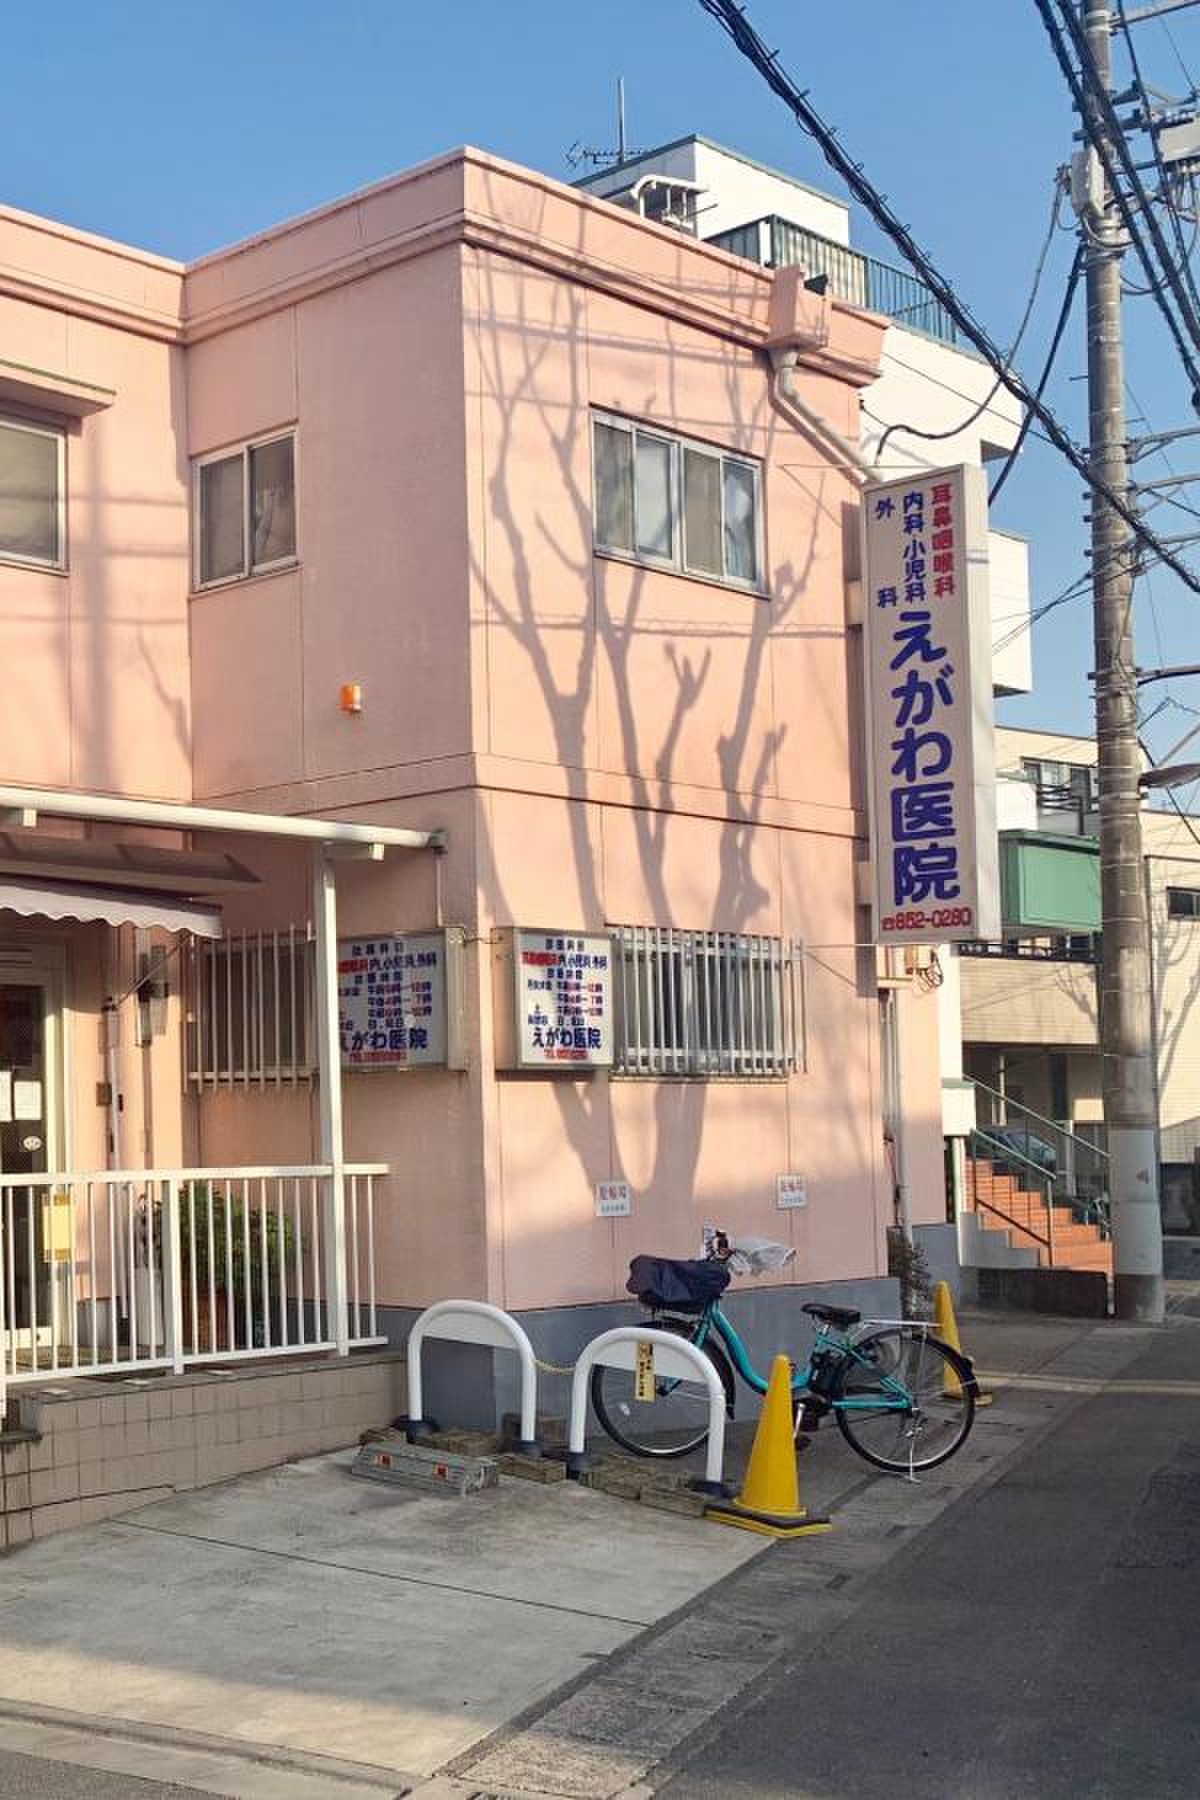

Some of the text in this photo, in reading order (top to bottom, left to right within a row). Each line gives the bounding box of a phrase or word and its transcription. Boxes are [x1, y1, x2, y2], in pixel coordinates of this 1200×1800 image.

[931, 483, 955, 600] 耳鼻咽喉科
[890, 610, 961, 907] えがわ医院
[532, 1027, 602, 1049] えがわ医院
